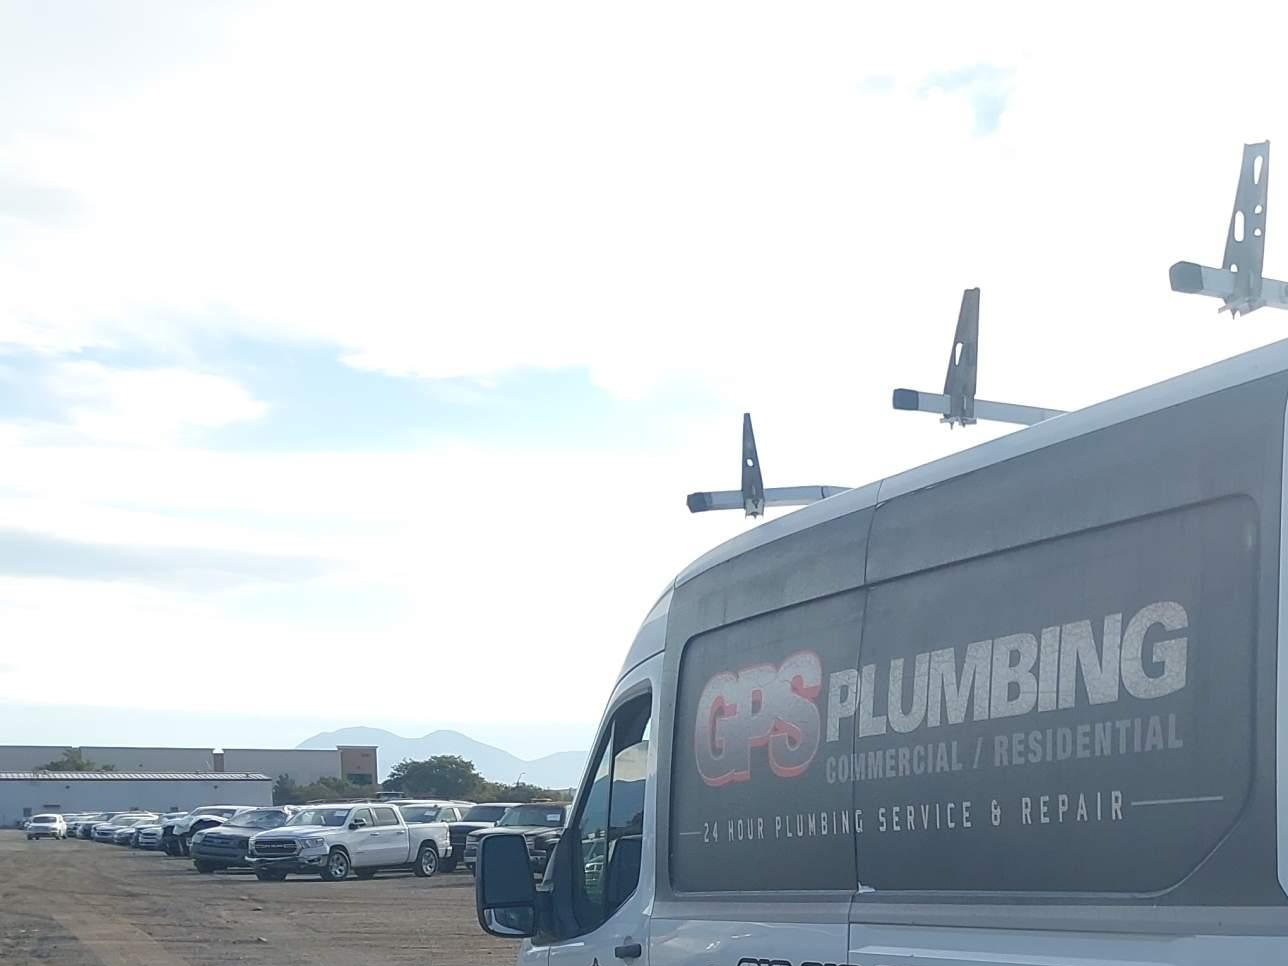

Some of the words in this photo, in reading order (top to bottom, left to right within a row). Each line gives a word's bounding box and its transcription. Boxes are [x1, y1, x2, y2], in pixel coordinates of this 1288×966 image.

[694, 648, 824, 788] GPS
[826, 600, 1190, 742] PLUMBING
[825, 740, 963, 785] COMMERCIAL
[993, 713, 1184, 768] RESIDENTIAL
[703, 821, 719, 843] 24
[728, 817, 765, 841] HOUR
[775, 808, 863, 839] PLUMBING
[878, 801, 972, 833] SERVICE
[991, 799, 1001, 826] &
[1021, 790, 1124, 825] REPAIR
